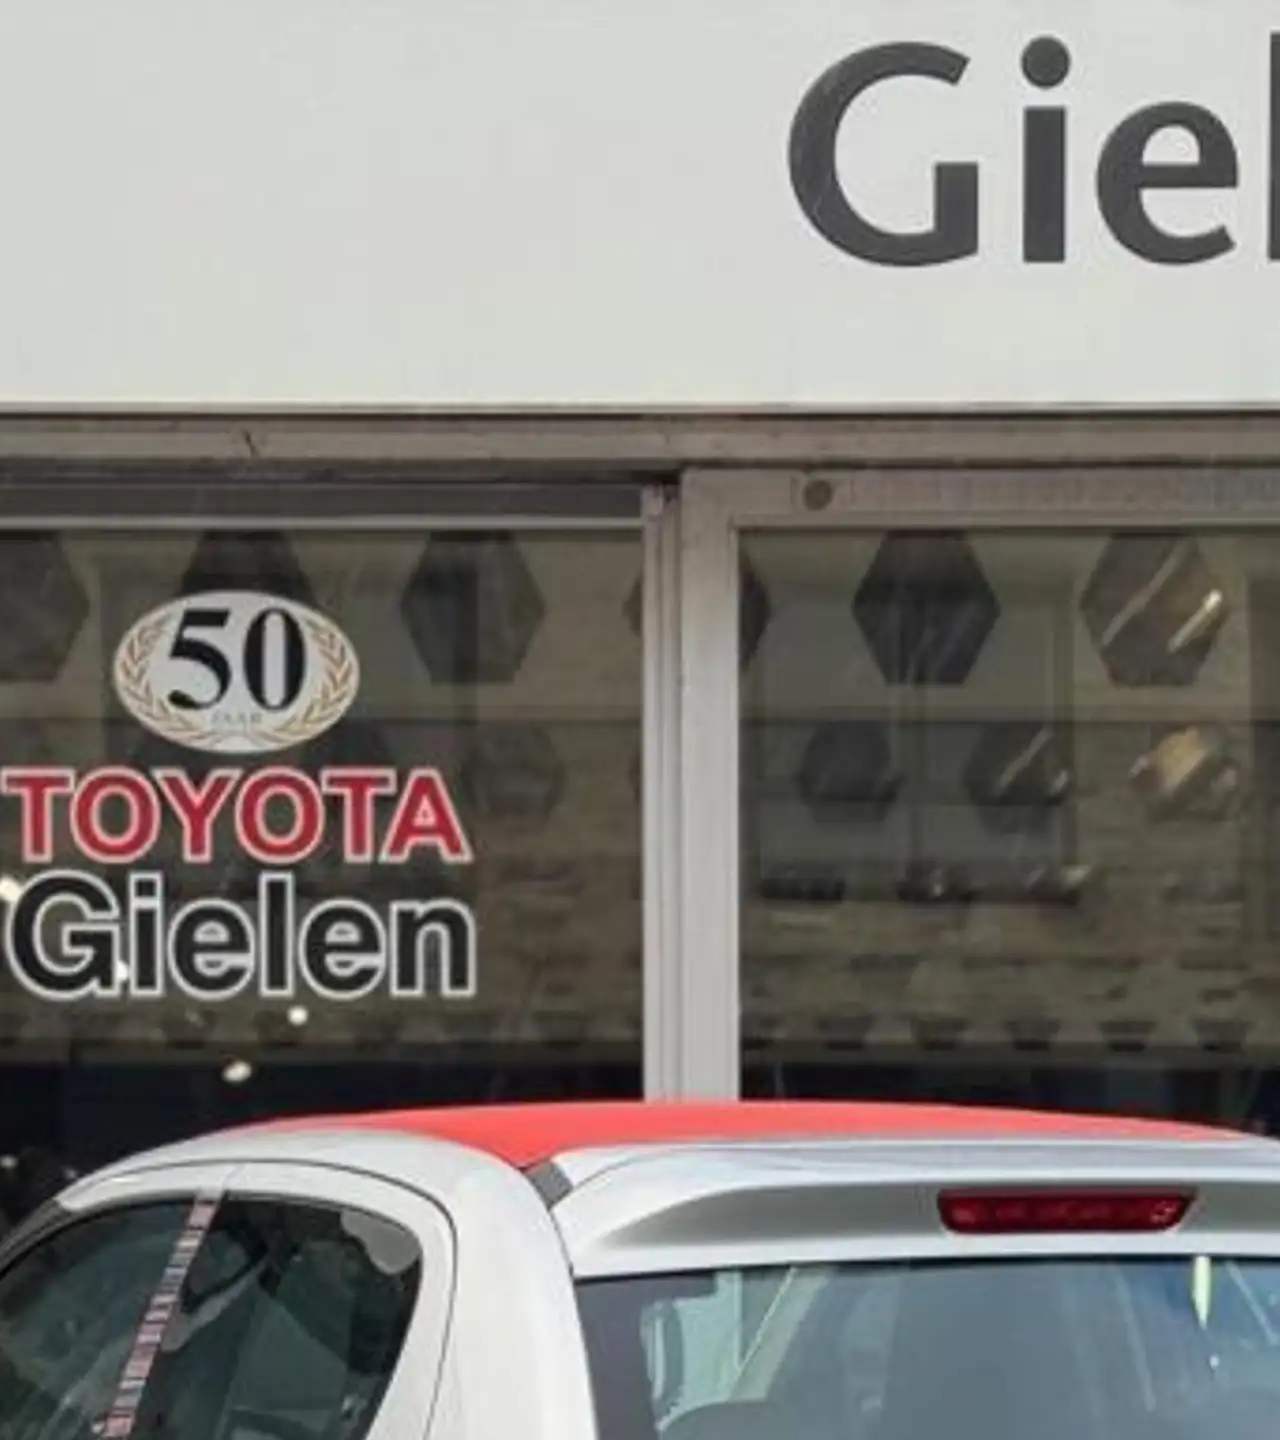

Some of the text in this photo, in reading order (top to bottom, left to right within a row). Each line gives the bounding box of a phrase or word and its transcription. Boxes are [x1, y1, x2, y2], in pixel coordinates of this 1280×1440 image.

[167, 606, 308, 711] 50
[0, 766, 473, 864] TOYOTA
[5, 869, 477, 998] Gielen
